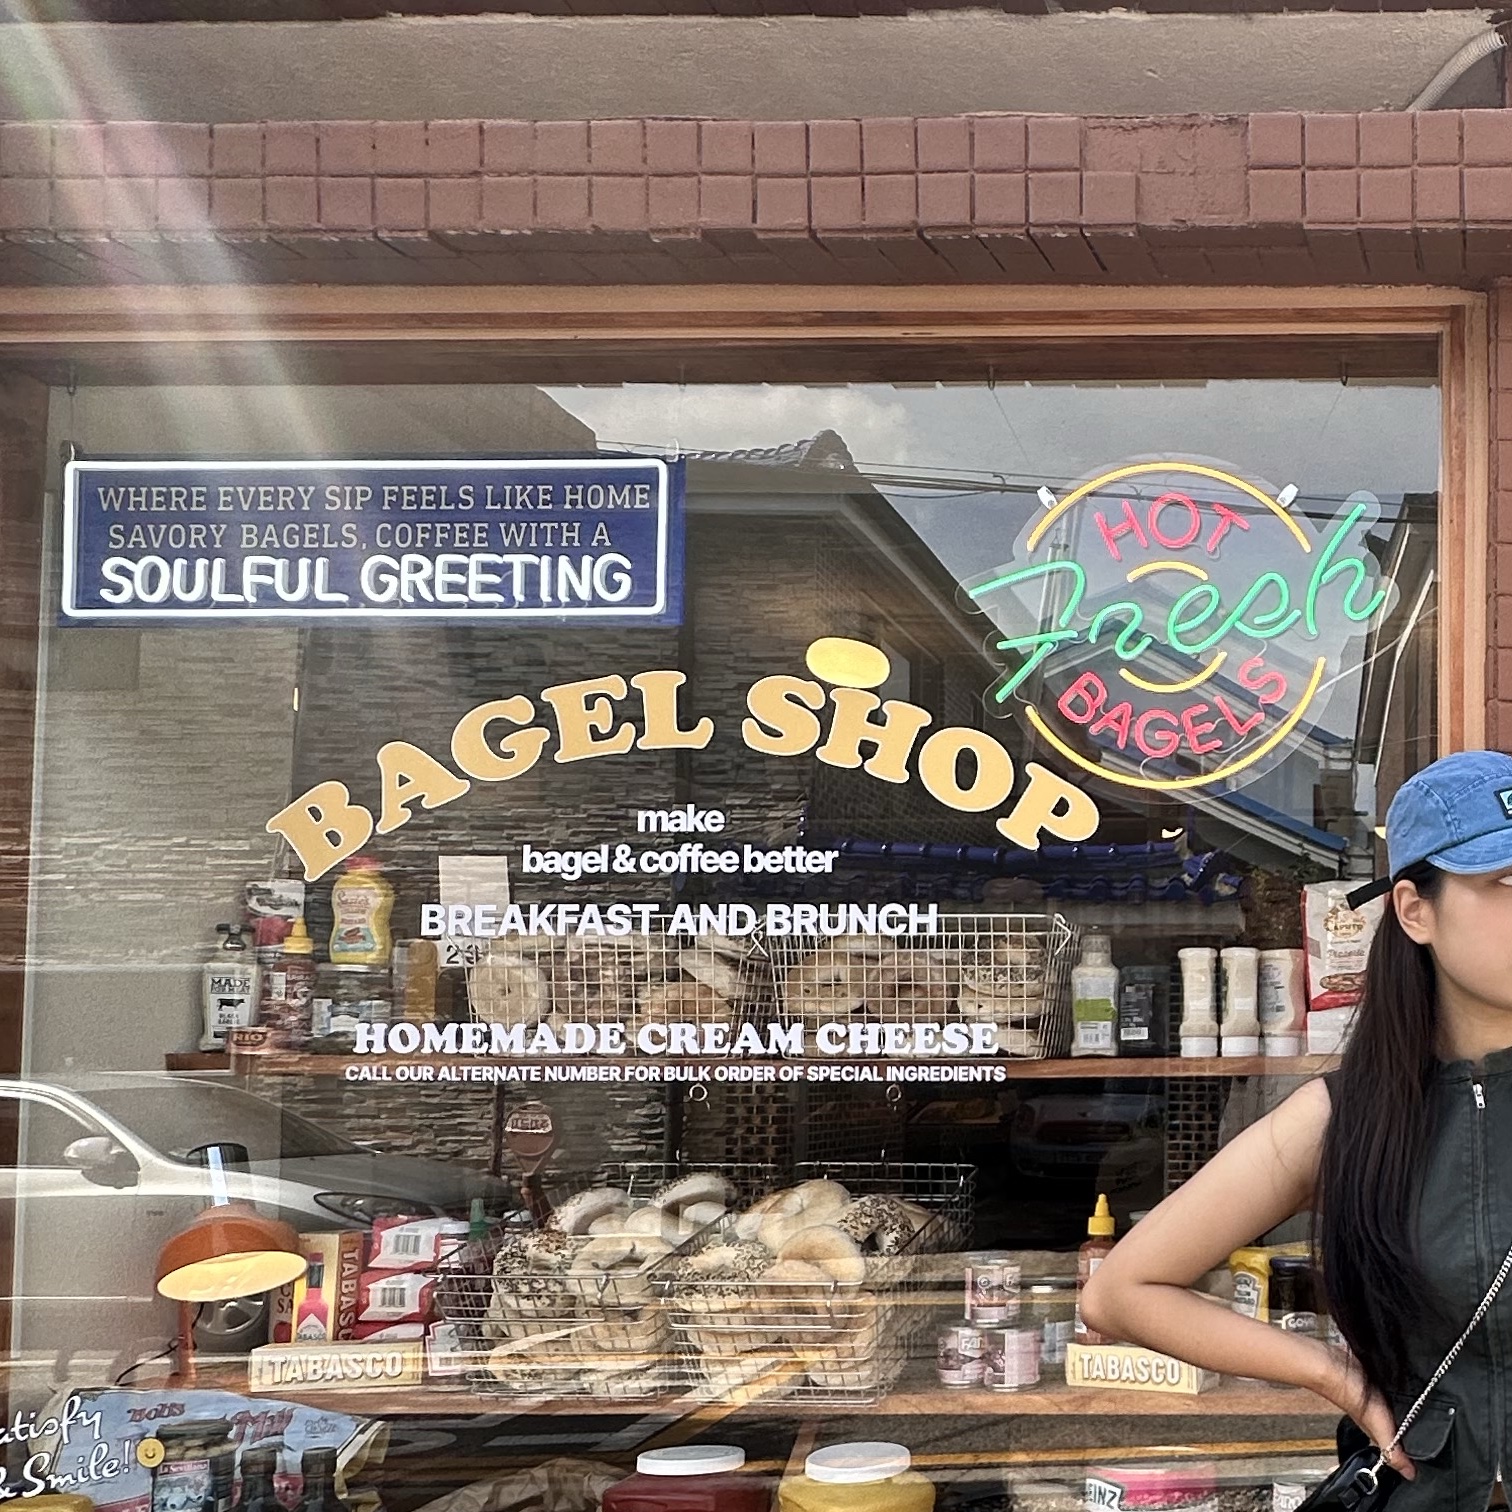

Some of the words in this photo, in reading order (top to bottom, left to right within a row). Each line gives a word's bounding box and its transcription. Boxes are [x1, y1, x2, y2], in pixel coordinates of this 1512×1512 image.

[98, 486, 207, 511] WHERE
[217, 486, 315, 511] EVERY
[324, 485, 373, 511] SIP
[382, 485, 475, 510] FEELS
[485, 485, 553, 510] LIKE
[563, 484, 650, 509] HOME
[108, 524, 227, 549] SAVORY
[240, 523, 368, 550] BAGELS,
[376, 522, 489, 548] COFFEE
[499, 522, 581, 547] WITH
[591, 521, 612, 547] A
[1094, 492, 1250, 561] HOT
[99, 555, 350, 603] SOULFUL
[360, 552, 633, 603] GREETING
[969, 503, 1387, 703] Fresh
[1057, 656, 1289, 758] BAGELS
[266, 670, 715, 883] BAGEL
[741, 675, 1100, 851] SHOP
[636, 803, 726, 833] make
[522, 844, 609, 881] bagel
[612, 846, 637, 873] &
[639, 843, 739, 873] coffee
[743, 844, 839, 873] better
[420, 904, 660, 936] BREAKFAST
[666, 903, 756, 936] AND
[766, 903, 938, 936] BRUNCH
[210, 977, 251, 987] MADE
[352, 1022, 626, 1055] HOMEMADE
[637, 1022, 805, 1055] CREAM
[815, 1022, 1000, 1055] CHEESE
[345, 1065, 392, 1082] CALL
[395, 1065, 435, 1082] OUR
[437, 1065, 542, 1082] ALTERNATE
[544, 1065, 621, 1082] NUMBER
[624, 1065, 661, 1082] FOR
[664, 1065, 712, 1082] BULK
[714, 1065, 776, 1082] ORDER
[778, 1065, 804, 1082] OF
[806, 1065, 883, 1082] SPECIAL
[886, 1065, 1008, 1082] INGREDIENTS
[338, 1249, 360, 1340] TABASC
[271, 1351, 404, 1385] TABASCO
[1079, 1353, 1182, 1386] TABASCO
[22, 1439, 131, 1498] Smile!
